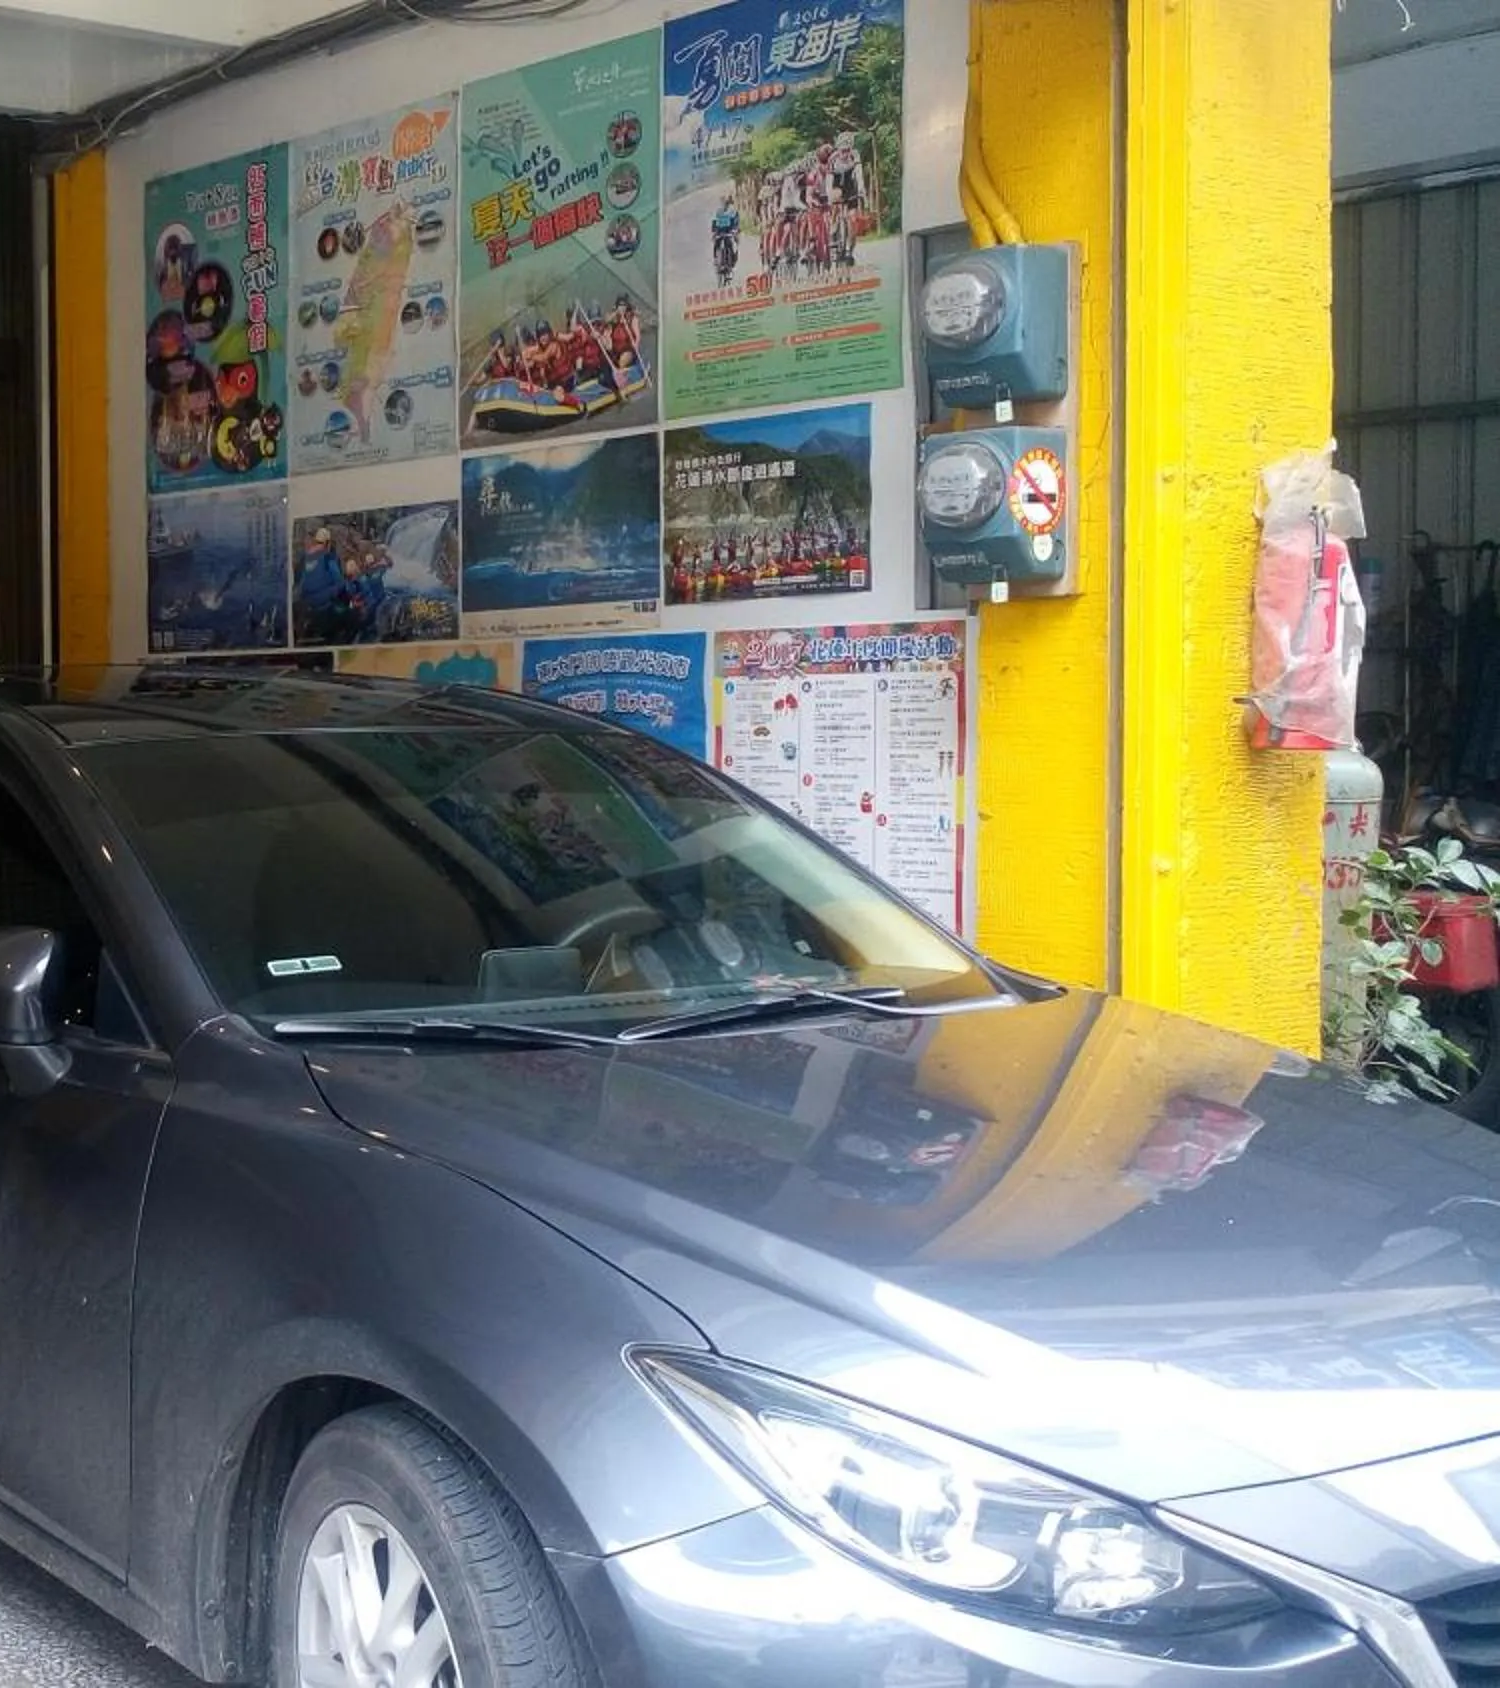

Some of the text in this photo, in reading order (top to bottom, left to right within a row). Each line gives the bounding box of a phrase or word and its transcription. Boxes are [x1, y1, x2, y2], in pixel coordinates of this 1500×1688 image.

[764, 12, 863, 74] 東海岸
[512, 145, 552, 178] Let's
[534, 157, 561, 192] go
[550, 165, 598, 200] rafting
